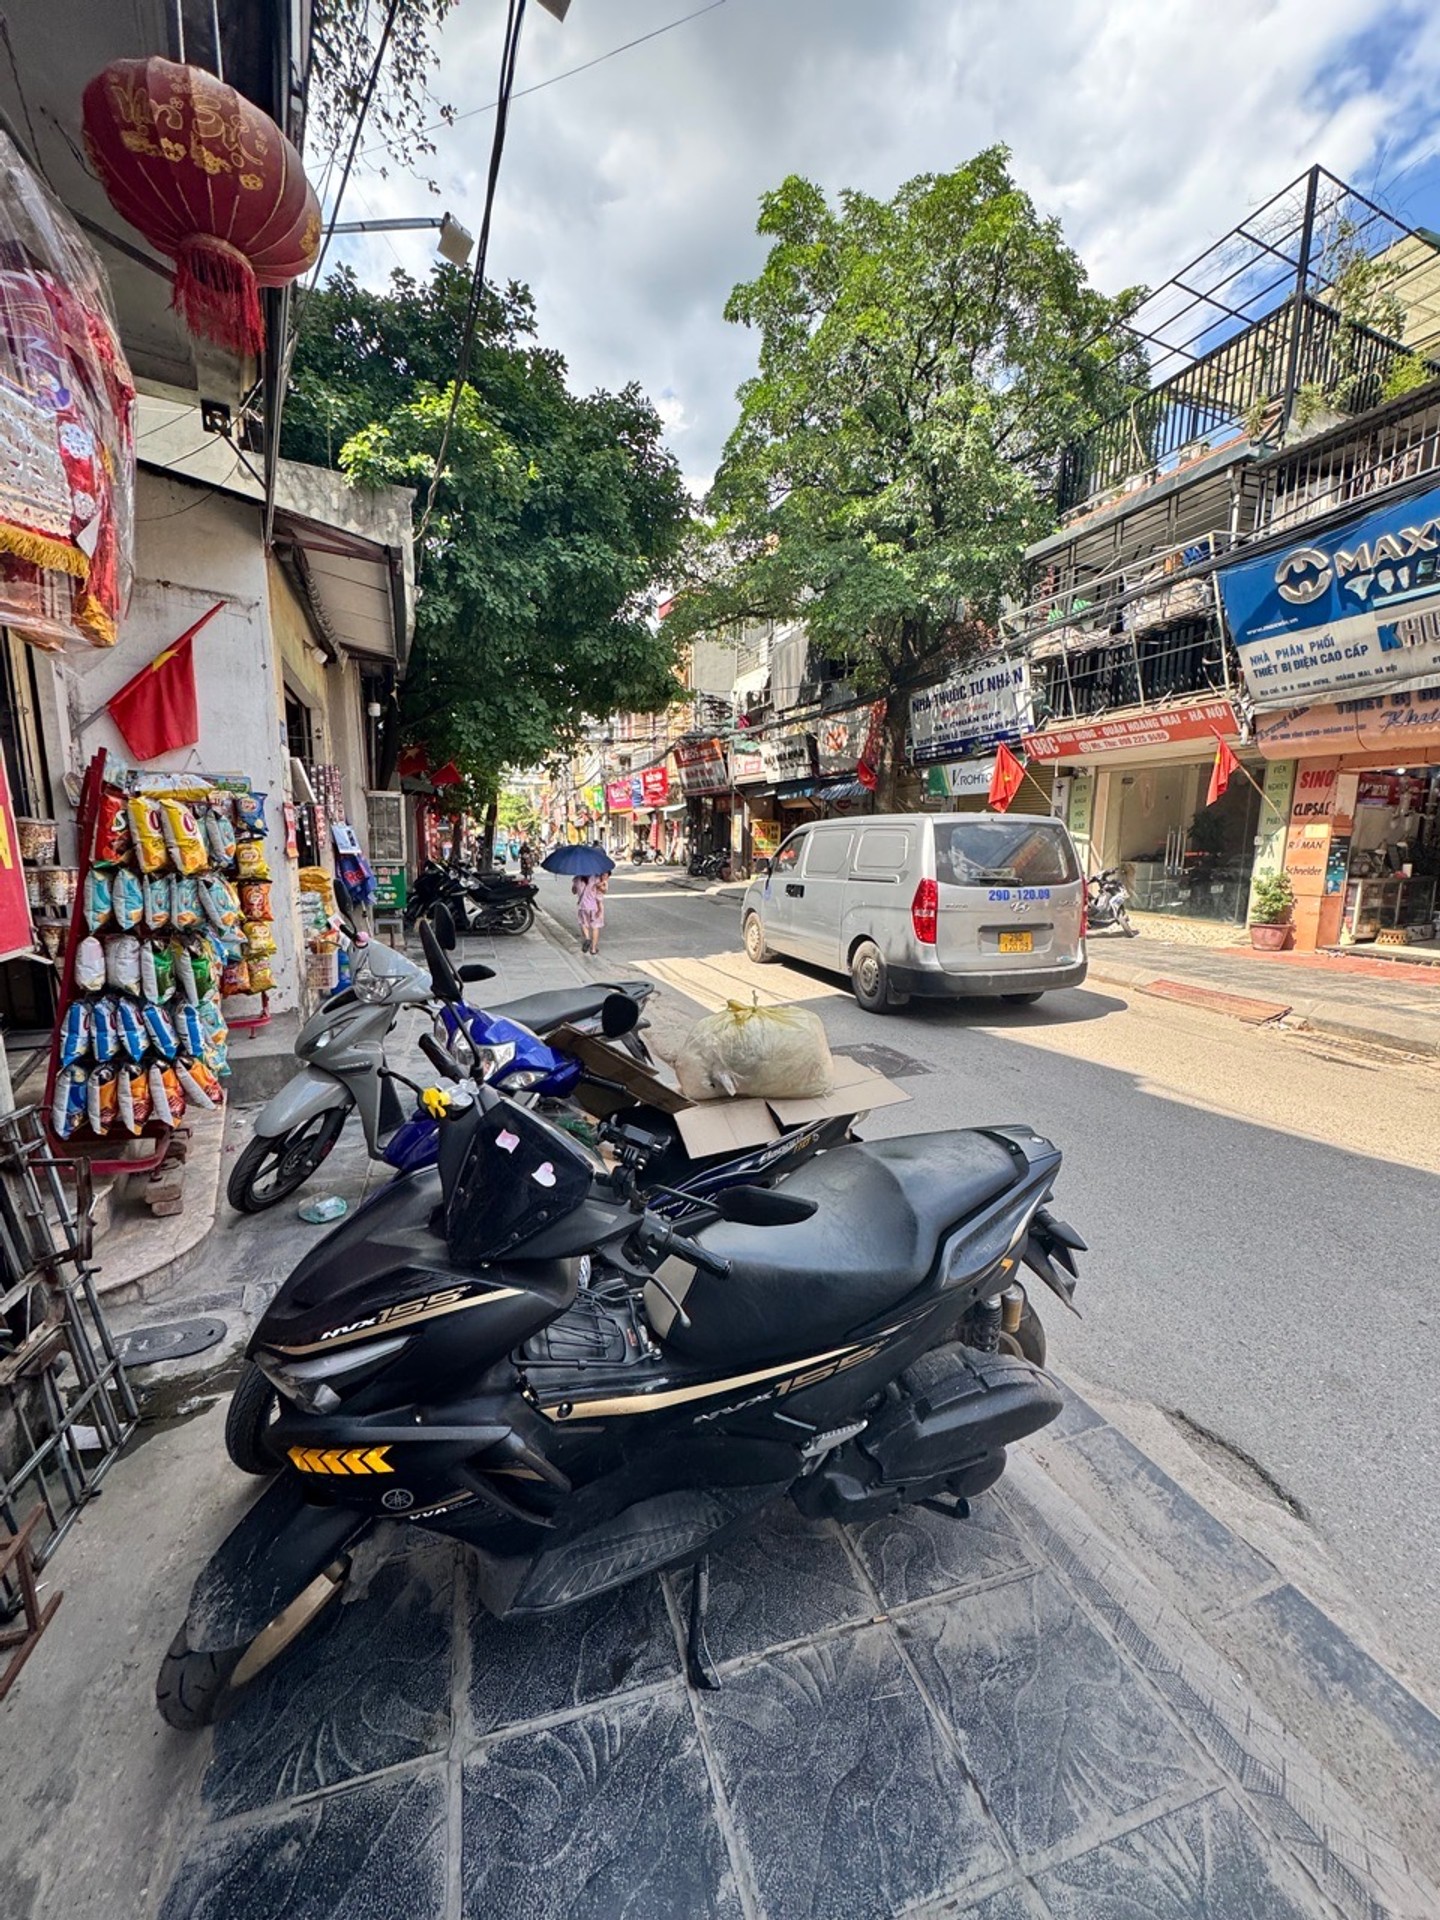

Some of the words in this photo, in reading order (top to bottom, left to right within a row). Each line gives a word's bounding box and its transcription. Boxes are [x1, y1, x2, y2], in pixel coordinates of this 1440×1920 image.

[1249, 650, 1270, 666] NHÀ
[1275, 643, 1305, 660] PHÂN
[1309, 633, 1335, 652] PHỐI
[1253, 663, 1278, 679] THIẾT
[1281, 661, 1292, 673] BỊ
[1293, 656, 1318, 670] ĐIỆN
[1320, 651, 1342, 664] CAO
[1345, 641, 1369, 658] CẤP
[934, 686, 967, 708] THUỐC
[970, 679, 985, 695] TƯ
[1102, 722, 1127, 737] QUẬN
[1127, 718, 1160, 733] HOÀNG
[1160, 714, 1182, 727] MAI
[1189, 709, 1206, 721] HÀ
[1207, 705, 1228, 719] NỘI
[1027, 737, 1060, 757] 198C
[1300, 770, 1335, 789] SINO
[1294, 801, 1332, 816] CLIPSAL
[1286, 865, 1322, 876] Schneider
[320, 1317, 377, 1341] NVX
[377, 1285, 472, 1324] 155
